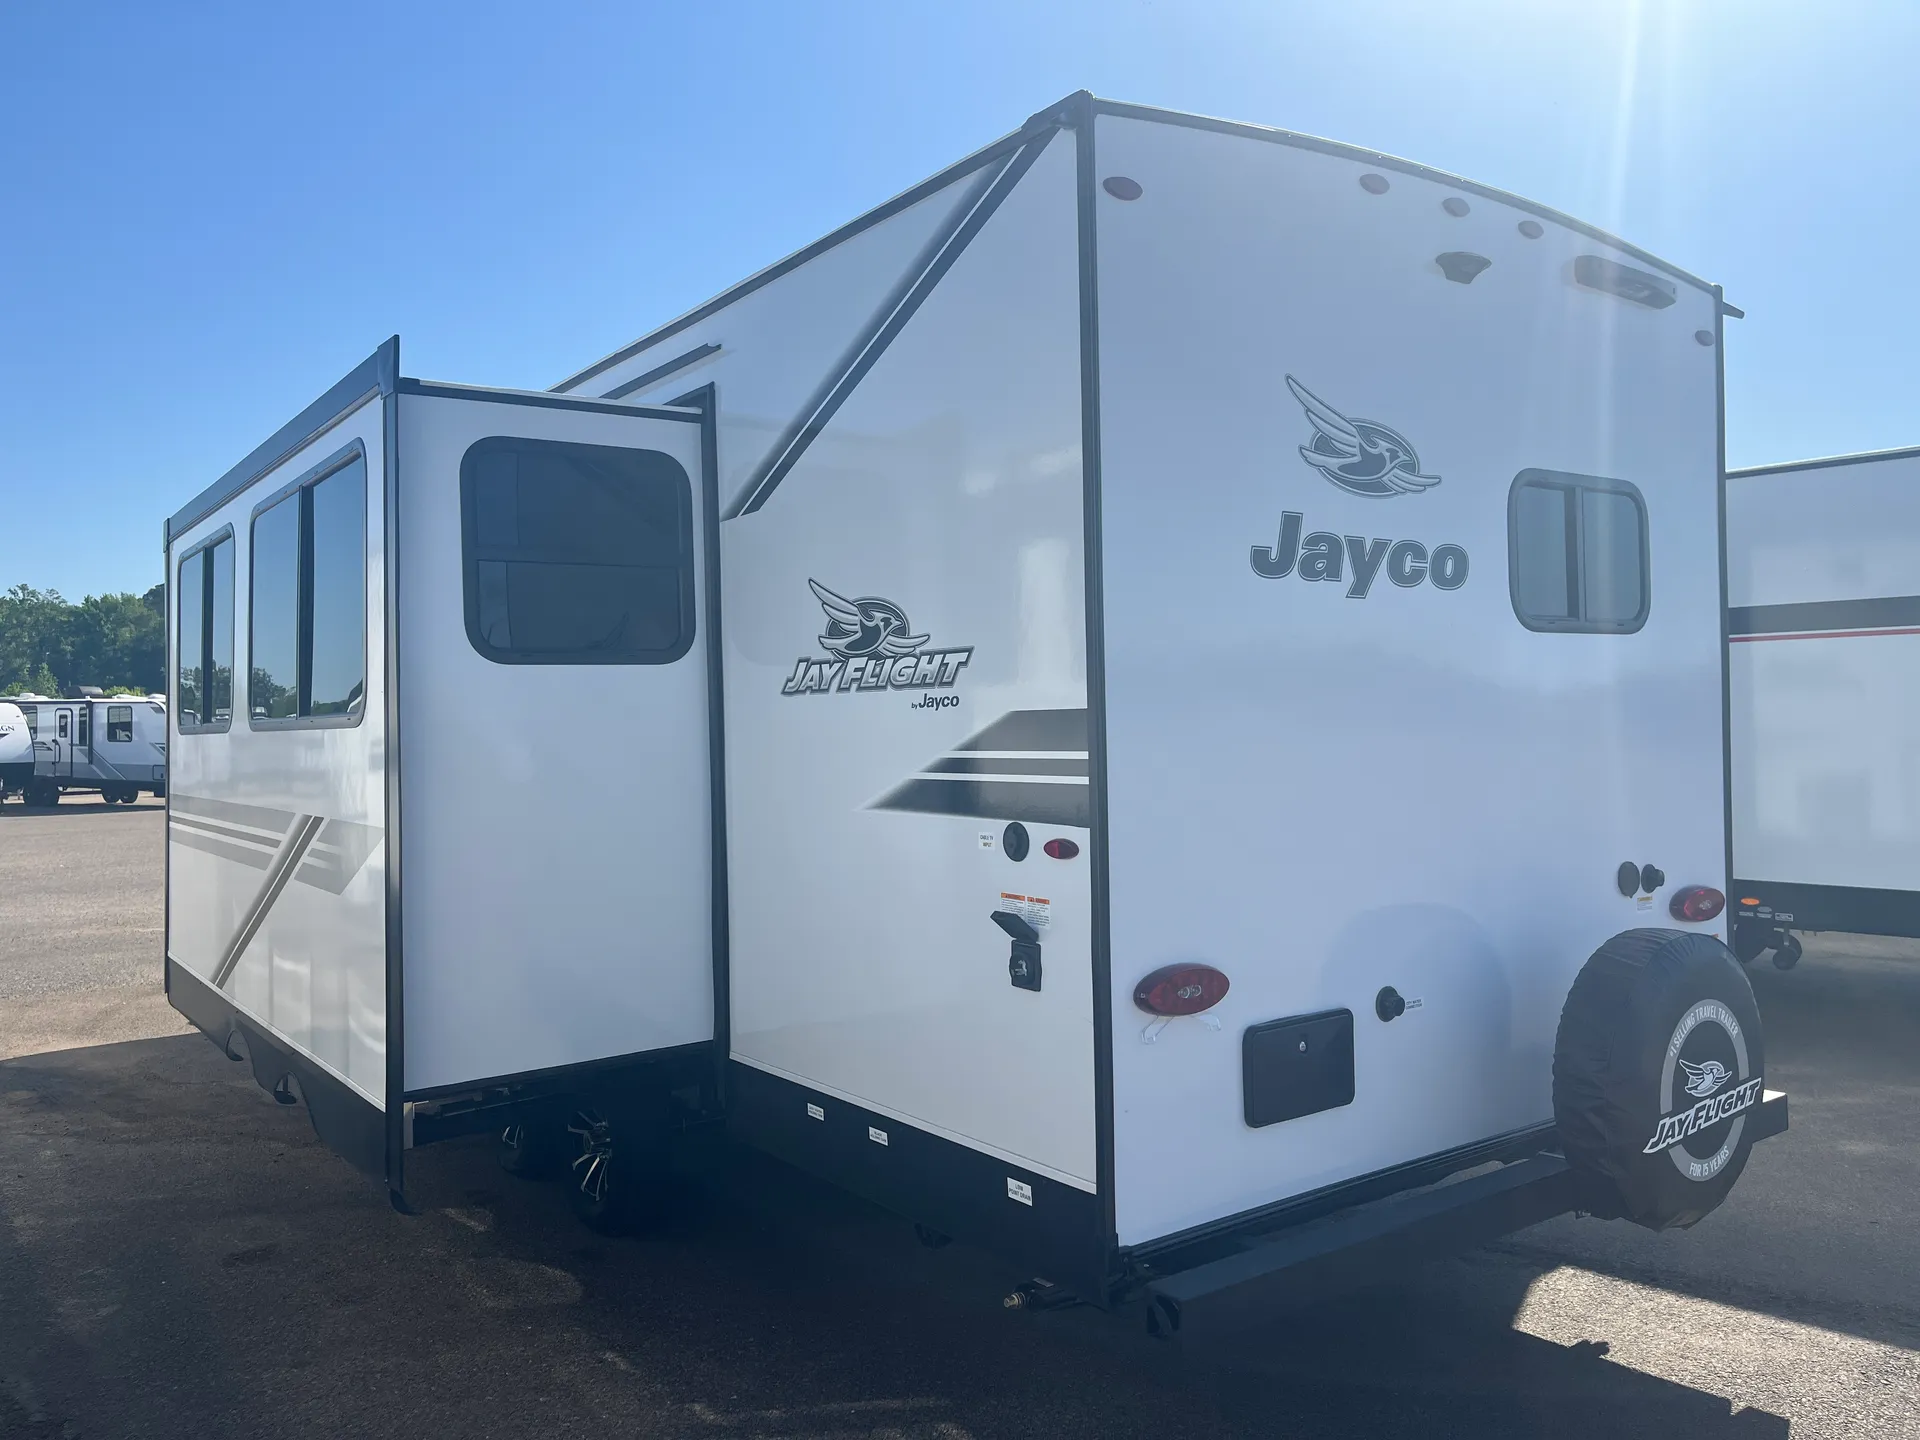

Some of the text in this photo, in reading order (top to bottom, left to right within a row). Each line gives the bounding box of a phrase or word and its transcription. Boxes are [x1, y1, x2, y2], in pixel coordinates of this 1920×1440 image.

[1250, 510, 1470, 600] Jayco
[911, 693, 960, 711] by Jayco
[0, 722, 14, 732] GN
[1673, 1012, 1696, 1048] SELLING
[1695, 1005, 1717, 1021] TRAVEL
[1717, 1007, 1739, 1039] TRAILER
[1689, 1145, 1730, 1177] FOR 15 YEARS
